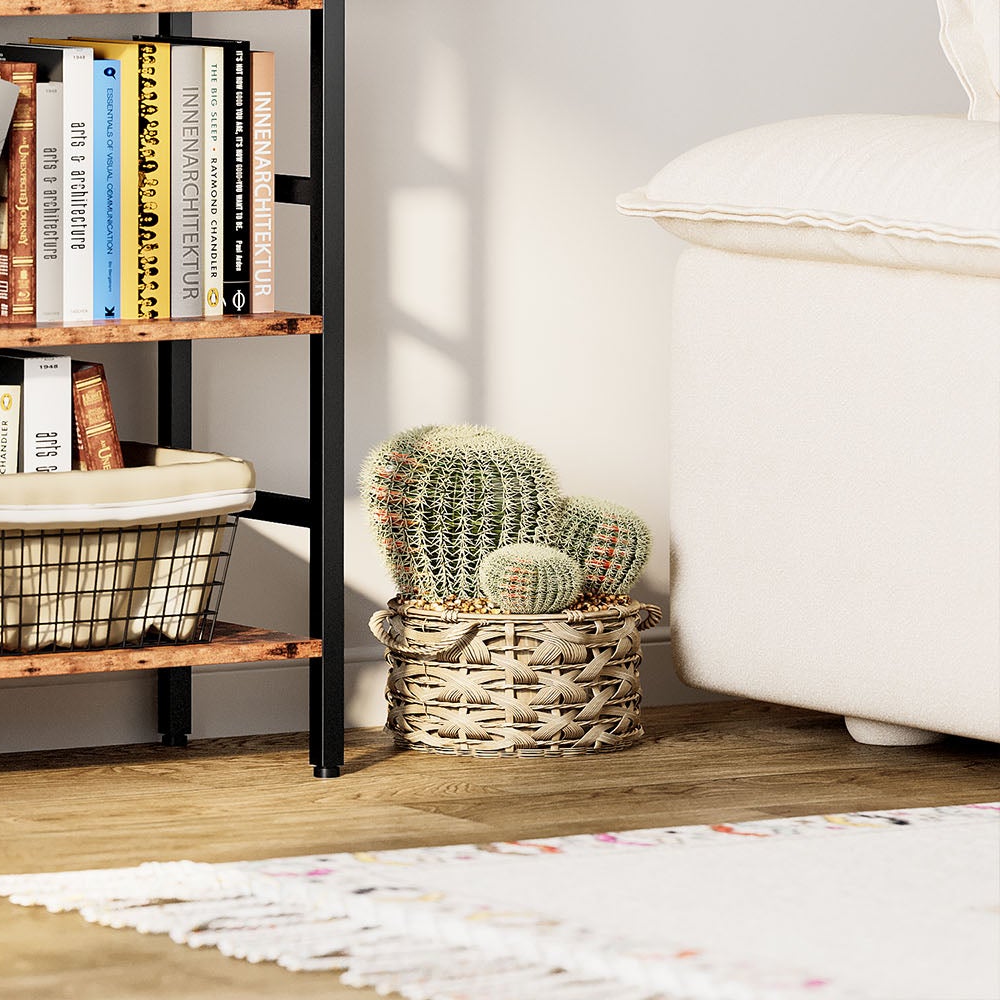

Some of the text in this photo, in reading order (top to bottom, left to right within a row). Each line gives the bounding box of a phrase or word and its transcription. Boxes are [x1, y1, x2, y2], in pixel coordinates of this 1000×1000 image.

[71, 122, 87, 147] arts
[235, 108, 243, 120] YOU
[43, 147, 58, 170] arts
[106, 87, 114, 255] ESSENTIALS OF VISUAL COMMUNICATION
[182, 87, 199, 300] INNENARCHITEKTUR
[210, 64, 218, 278] THE BIG SLEEP RAYMOND CHANDLER
[254, 91, 272, 296] INNENARCHITEKTUR
[43, 190, 60, 260] architecture
[70, 170, 88, 250] architecture
[0, 420, 9, 475] CHANDLER
[36, 432, 61, 457] arts
